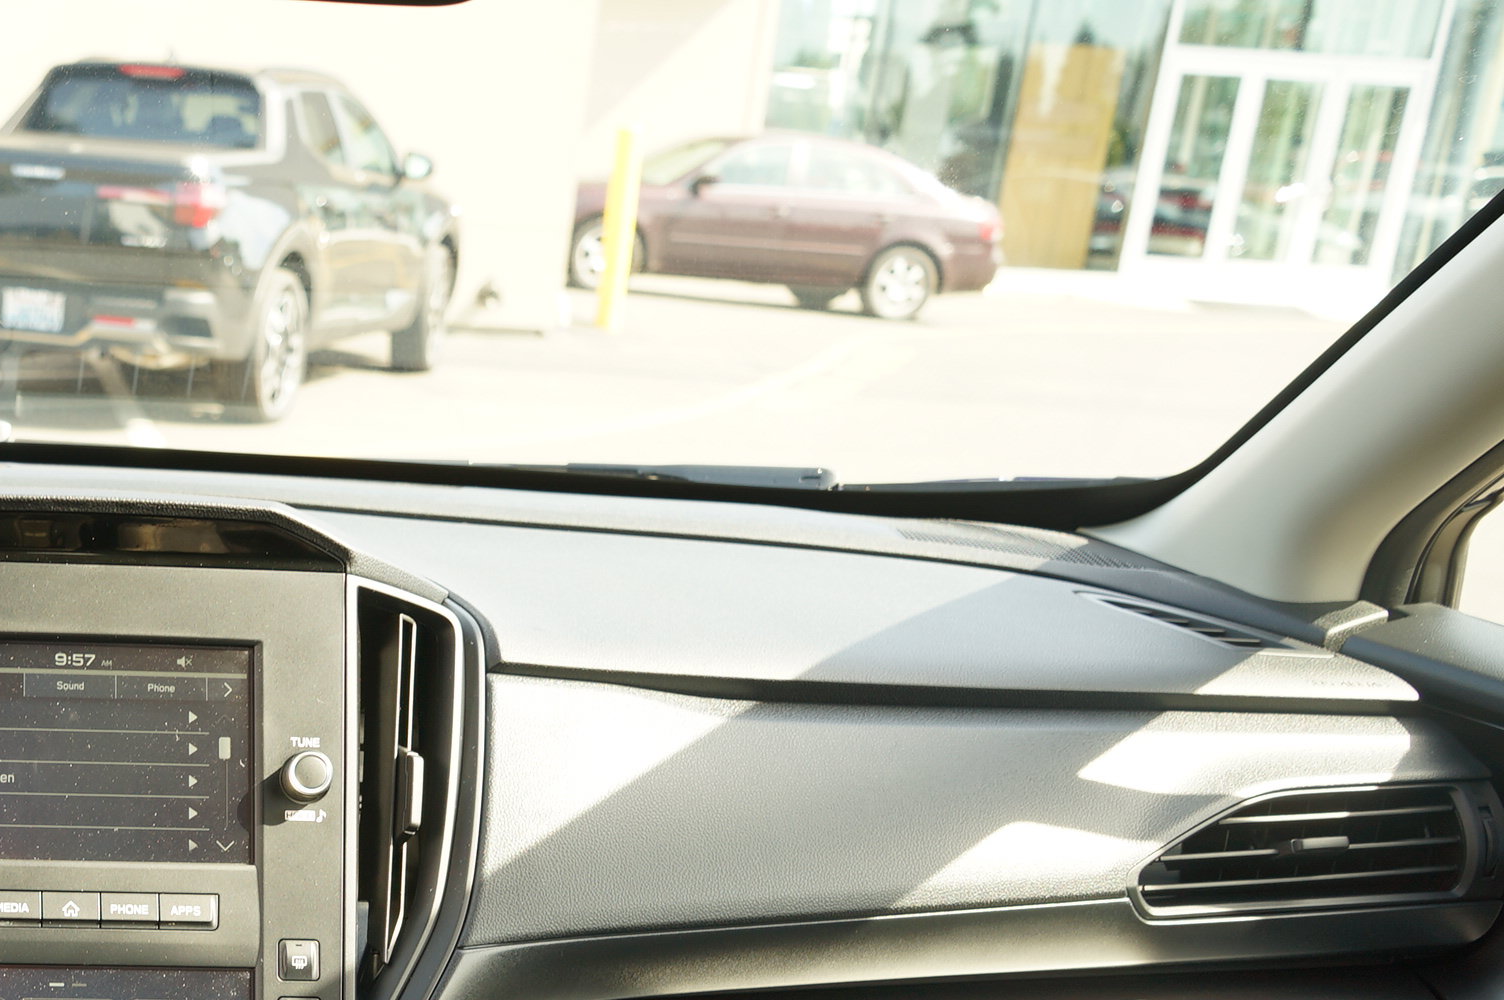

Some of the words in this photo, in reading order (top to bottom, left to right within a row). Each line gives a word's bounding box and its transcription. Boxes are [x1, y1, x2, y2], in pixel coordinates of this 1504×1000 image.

[54, 652, 96, 667] 9:57
[56, 680, 85, 691] Sound
[147, 683, 176, 693] Phone
[290, 736, 321, 748] TUNE
[109, 903, 149, 915] PHONE
[170, 905, 201, 917] APPS
